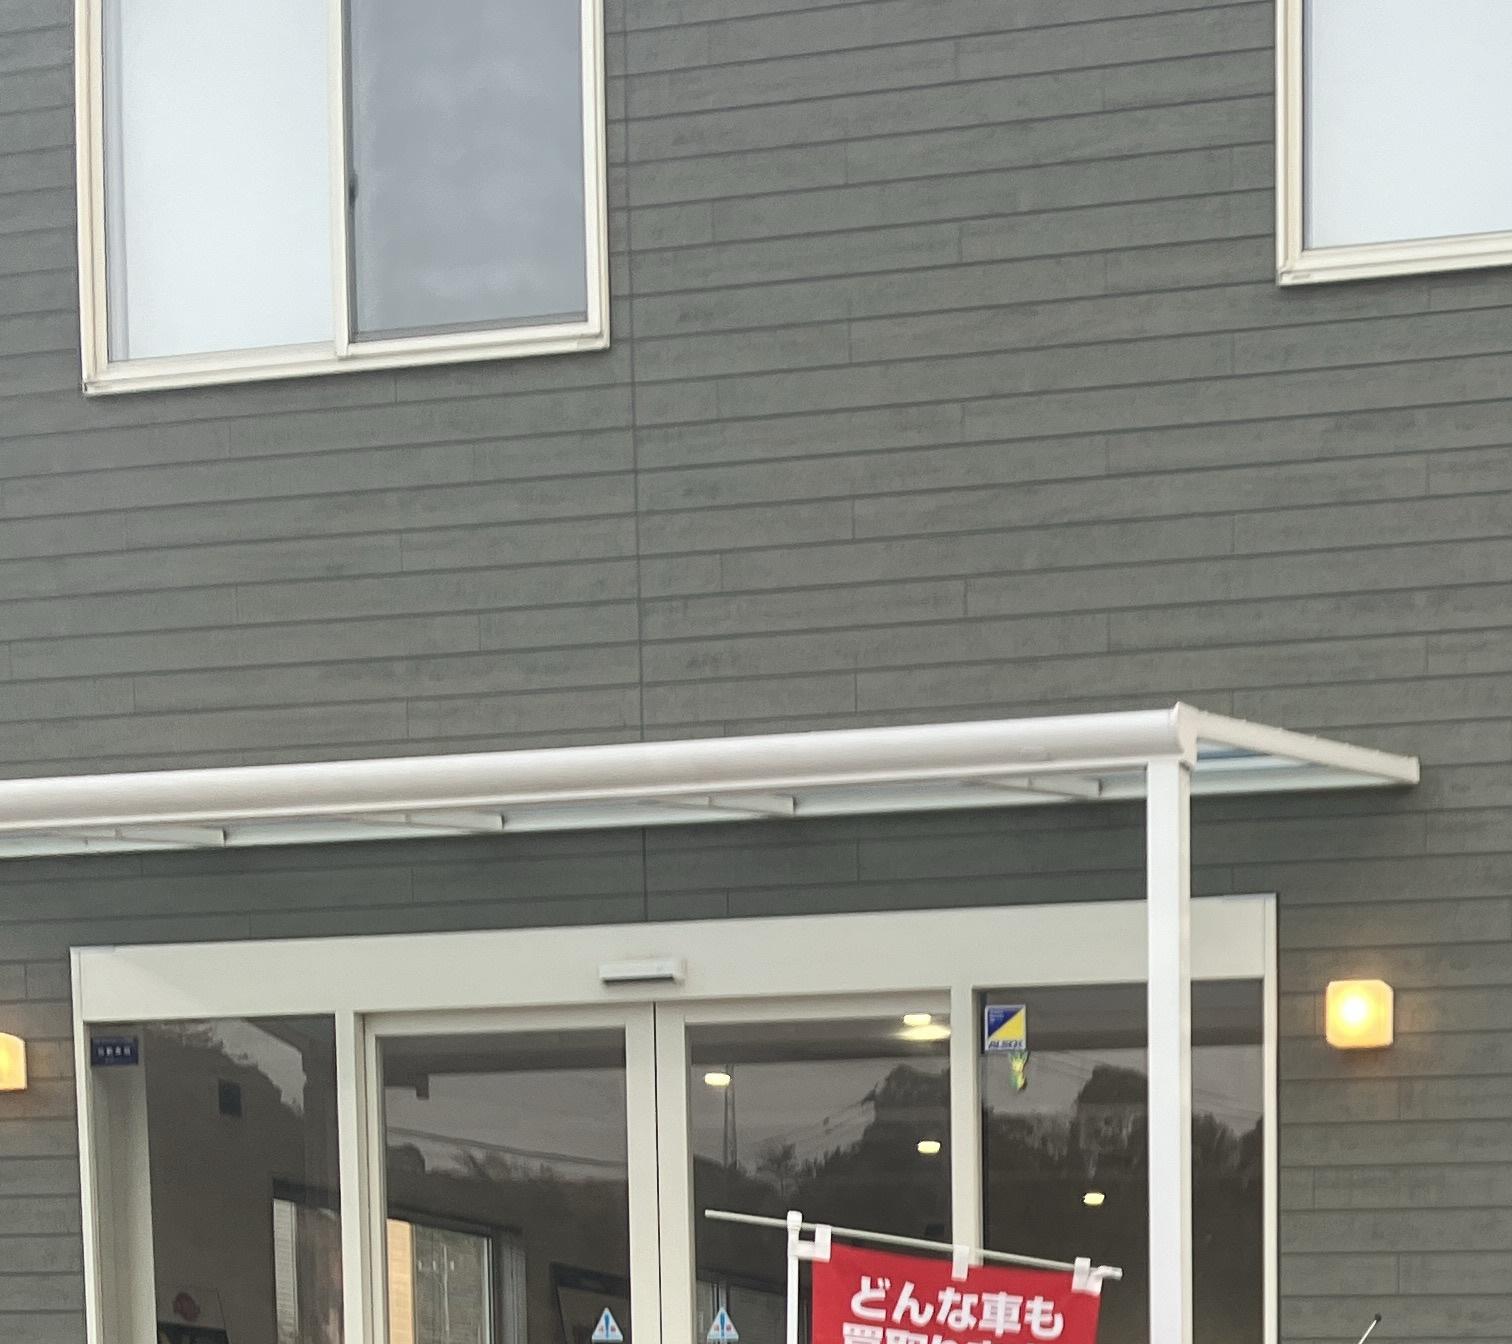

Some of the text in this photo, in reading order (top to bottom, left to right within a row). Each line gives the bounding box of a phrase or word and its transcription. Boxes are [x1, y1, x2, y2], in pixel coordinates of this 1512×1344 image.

[850, 1275, 1065, 1341] どんな車も
